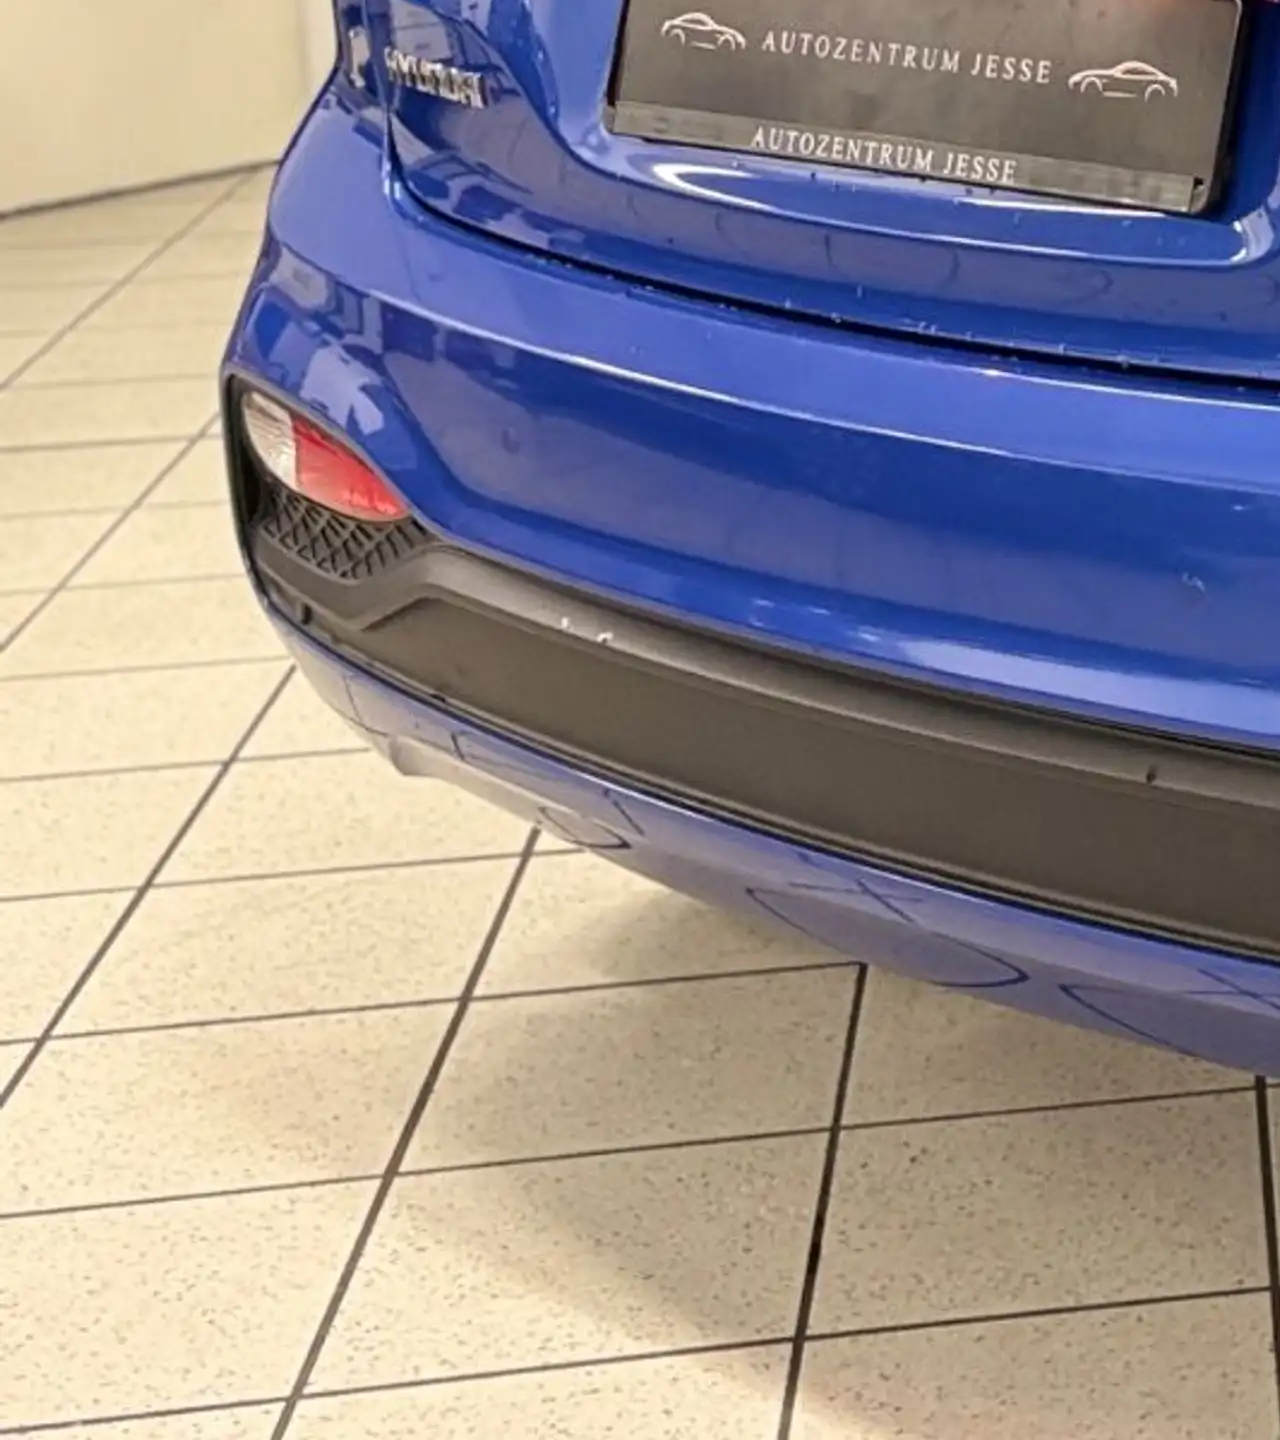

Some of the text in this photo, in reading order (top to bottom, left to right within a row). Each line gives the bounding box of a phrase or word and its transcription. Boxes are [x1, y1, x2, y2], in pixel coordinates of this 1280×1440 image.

[761, 31, 1052, 85] AUTOZENTRUM JESSE
[751, 127, 1017, 183] AUTOZENTRUM JESSE
